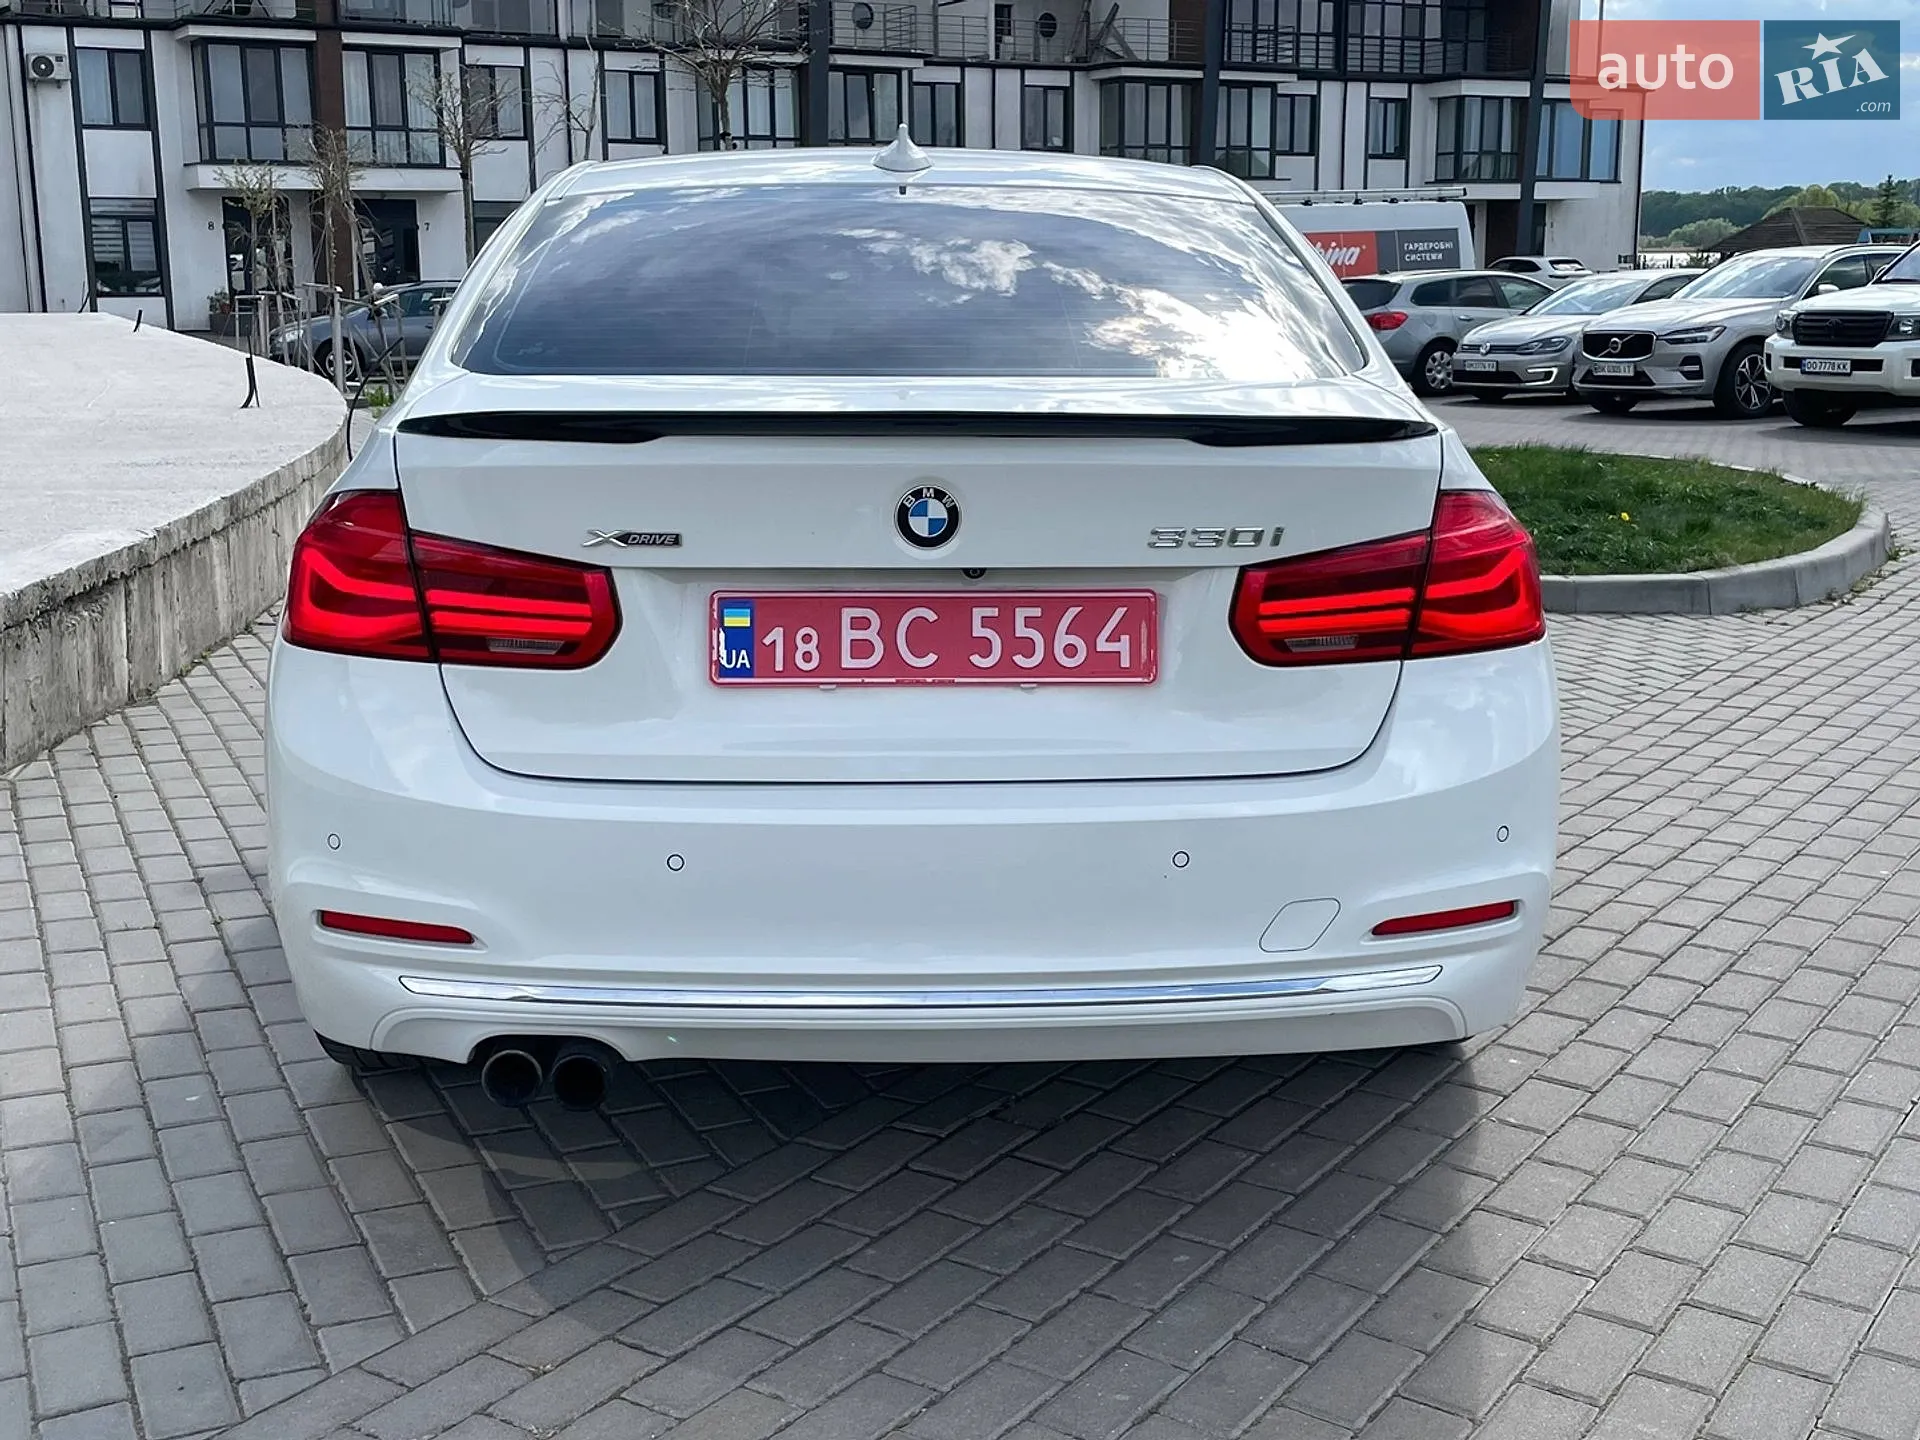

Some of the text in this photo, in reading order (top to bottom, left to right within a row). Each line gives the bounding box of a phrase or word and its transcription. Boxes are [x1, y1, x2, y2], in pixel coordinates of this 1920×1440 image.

[207, 221, 215, 231] 8
[424, 222, 431, 232] 7
[1404, 241, 1454, 251] ГАРДЕРОБНІ
[1405, 253, 1443, 262] СИСТЕМИ
[902, 487, 956, 508] BMW
[1147, 526, 1285, 548] 330i
[761, 606, 1130, 672] 18 BC 5564
[723, 649, 751, 669] UA
